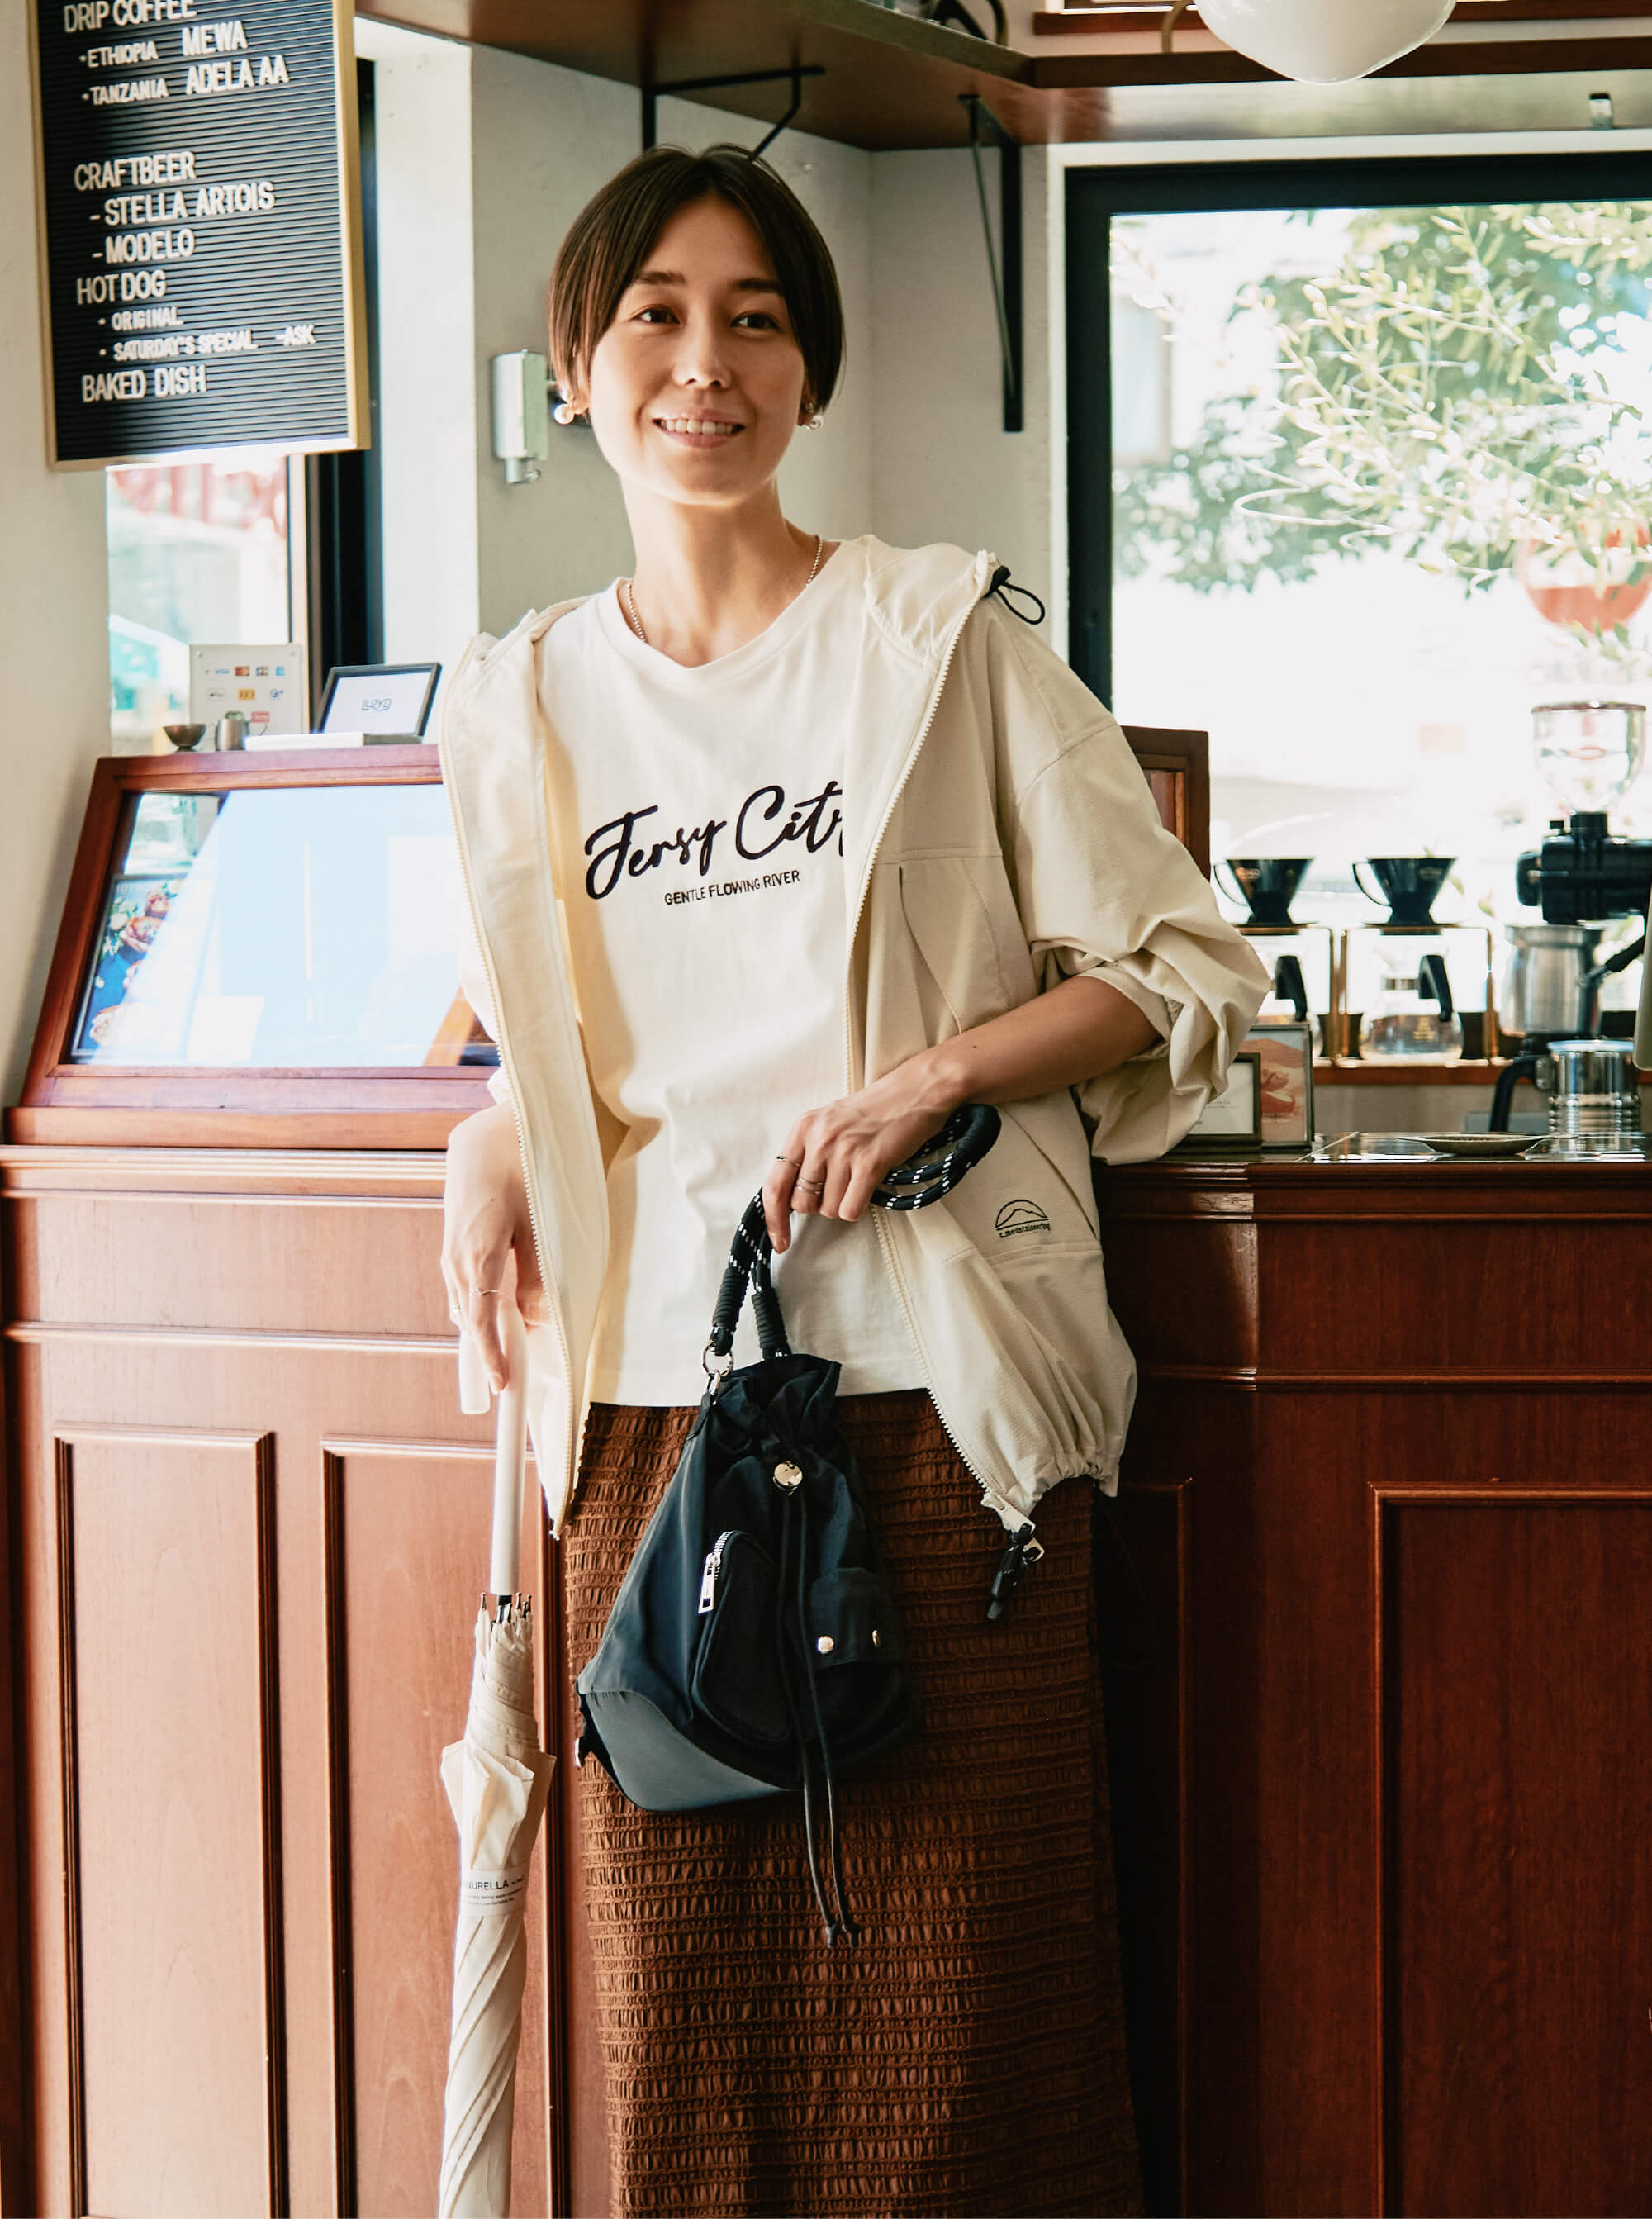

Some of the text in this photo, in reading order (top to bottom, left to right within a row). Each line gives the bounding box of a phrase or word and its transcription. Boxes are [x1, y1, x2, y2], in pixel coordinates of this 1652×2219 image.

[64, 0, 197, 33] DRIP COFFEE
[87, 21, 249, 68] ETHIOPIA MEWA
[89, 55, 290, 106] TANZANIA ADELA AA
[74, 151, 197, 191] CRAFTBEER
[196, 181, 275, 217] ARTOIS
[77, 269, 167, 305] HOT DOG
[112, 306, 183, 330] ORIGINAL
[114, 335, 196, 361] SATURDAY'S
[198, 330, 258, 354] SPECIAL
[83, 364, 207, 402] BAKED DISH
[664, 870, 800, 905] GENTLE FLOWING RIVER
